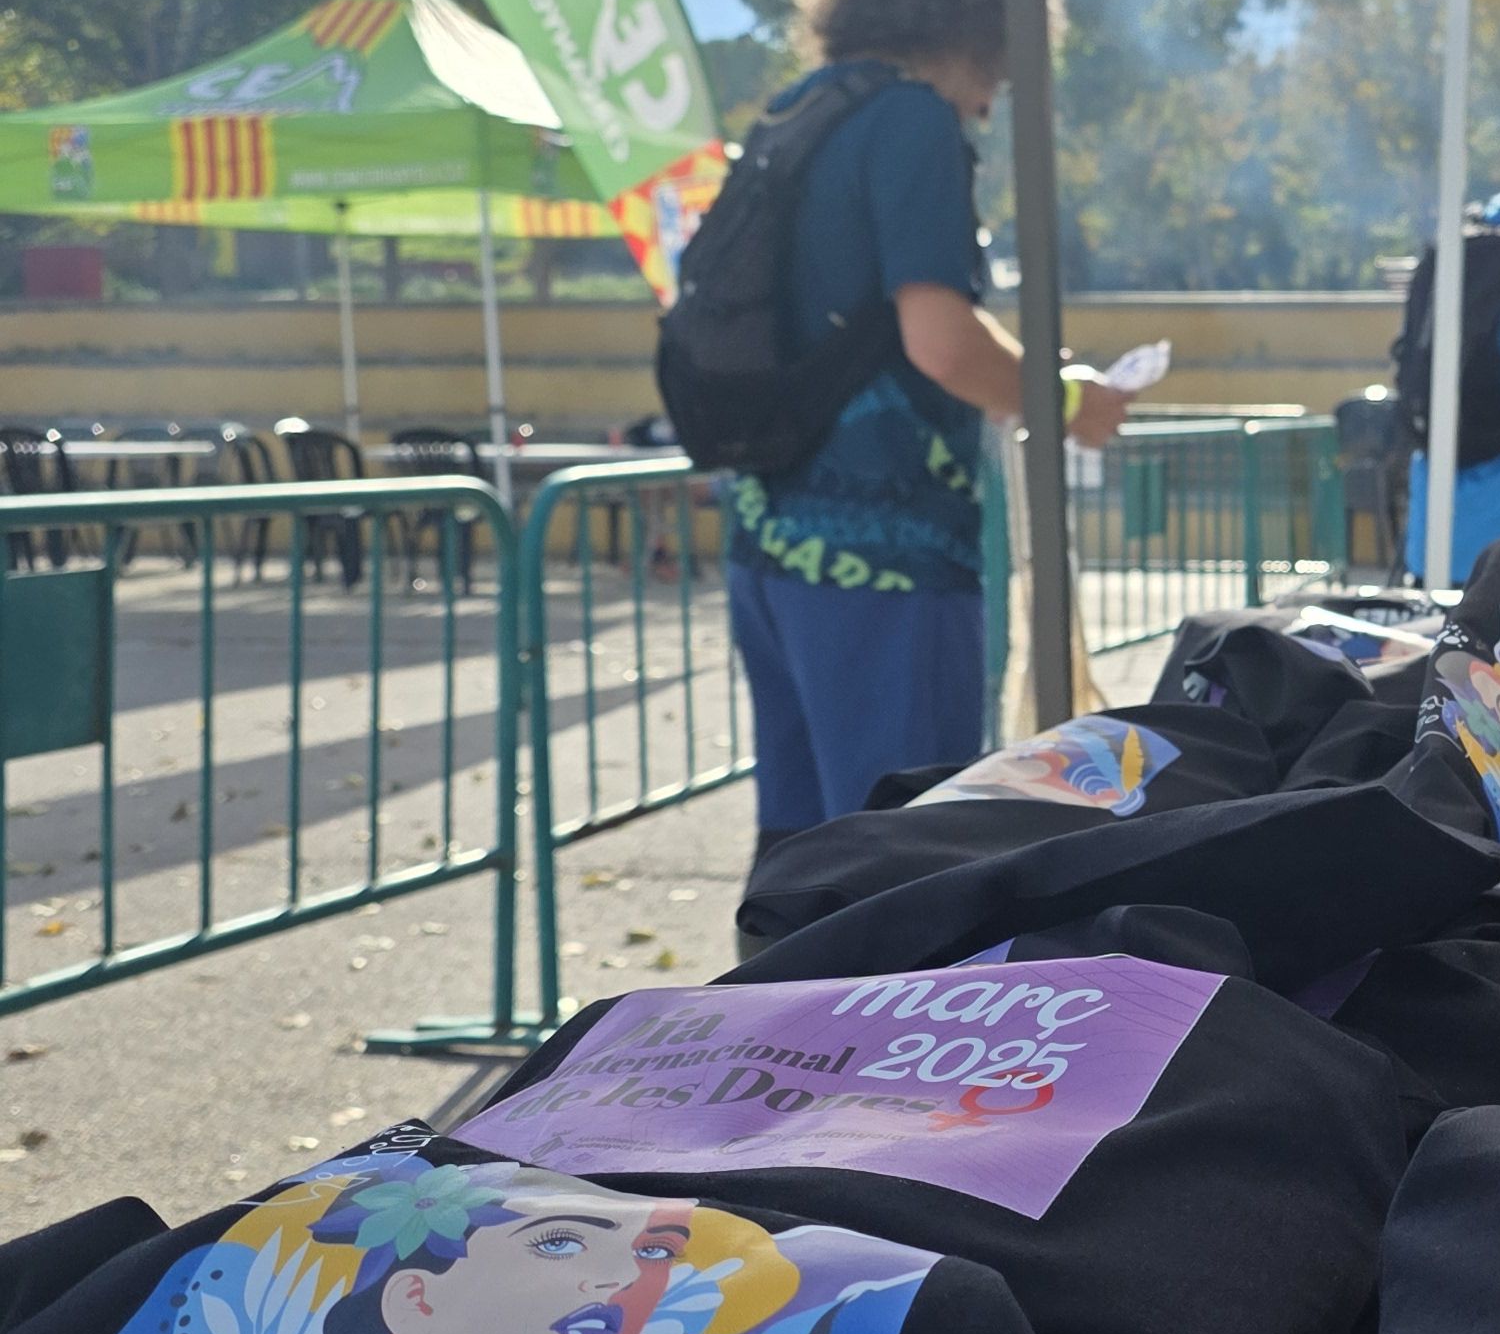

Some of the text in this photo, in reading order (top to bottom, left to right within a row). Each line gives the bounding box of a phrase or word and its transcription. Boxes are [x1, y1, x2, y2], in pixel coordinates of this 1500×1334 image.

[831, 979, 1112, 1041] març
[857, 1033, 1088, 1091] 2025
[503, 1067, 946, 1123] de les Dones
